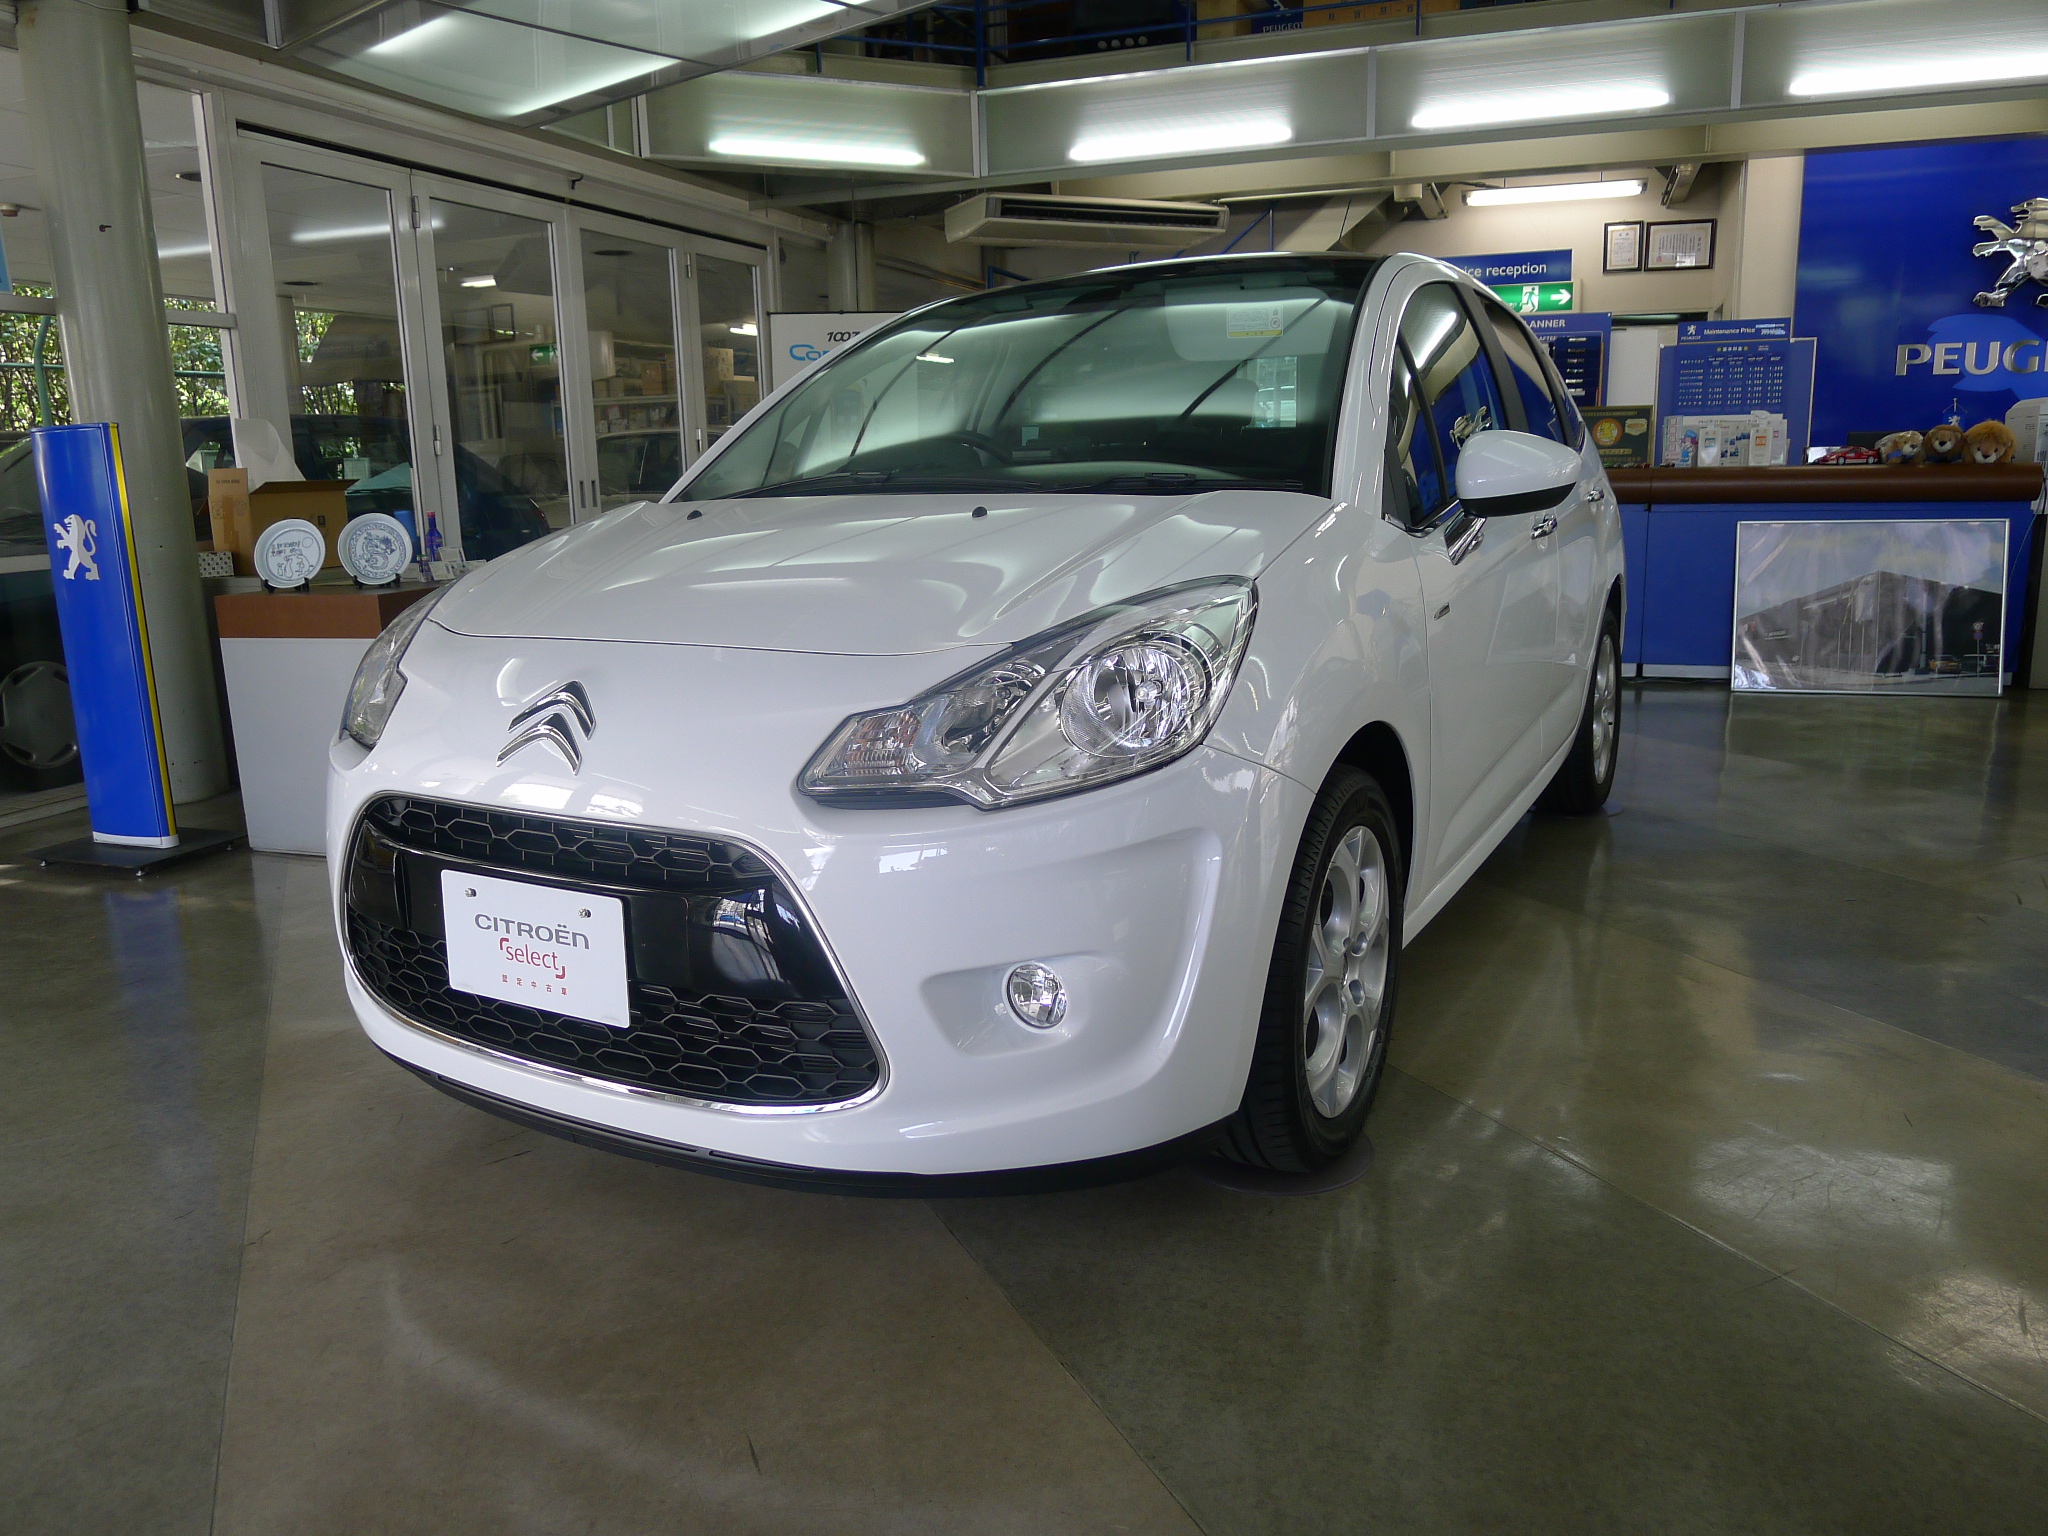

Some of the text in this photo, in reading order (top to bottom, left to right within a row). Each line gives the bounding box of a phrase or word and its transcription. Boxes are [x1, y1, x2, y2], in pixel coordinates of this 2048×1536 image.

[1486, 262, 1547, 278] reception
[1895, 339, 2048, 376] PEUG
[474, 913, 590, 950] CITROËN
